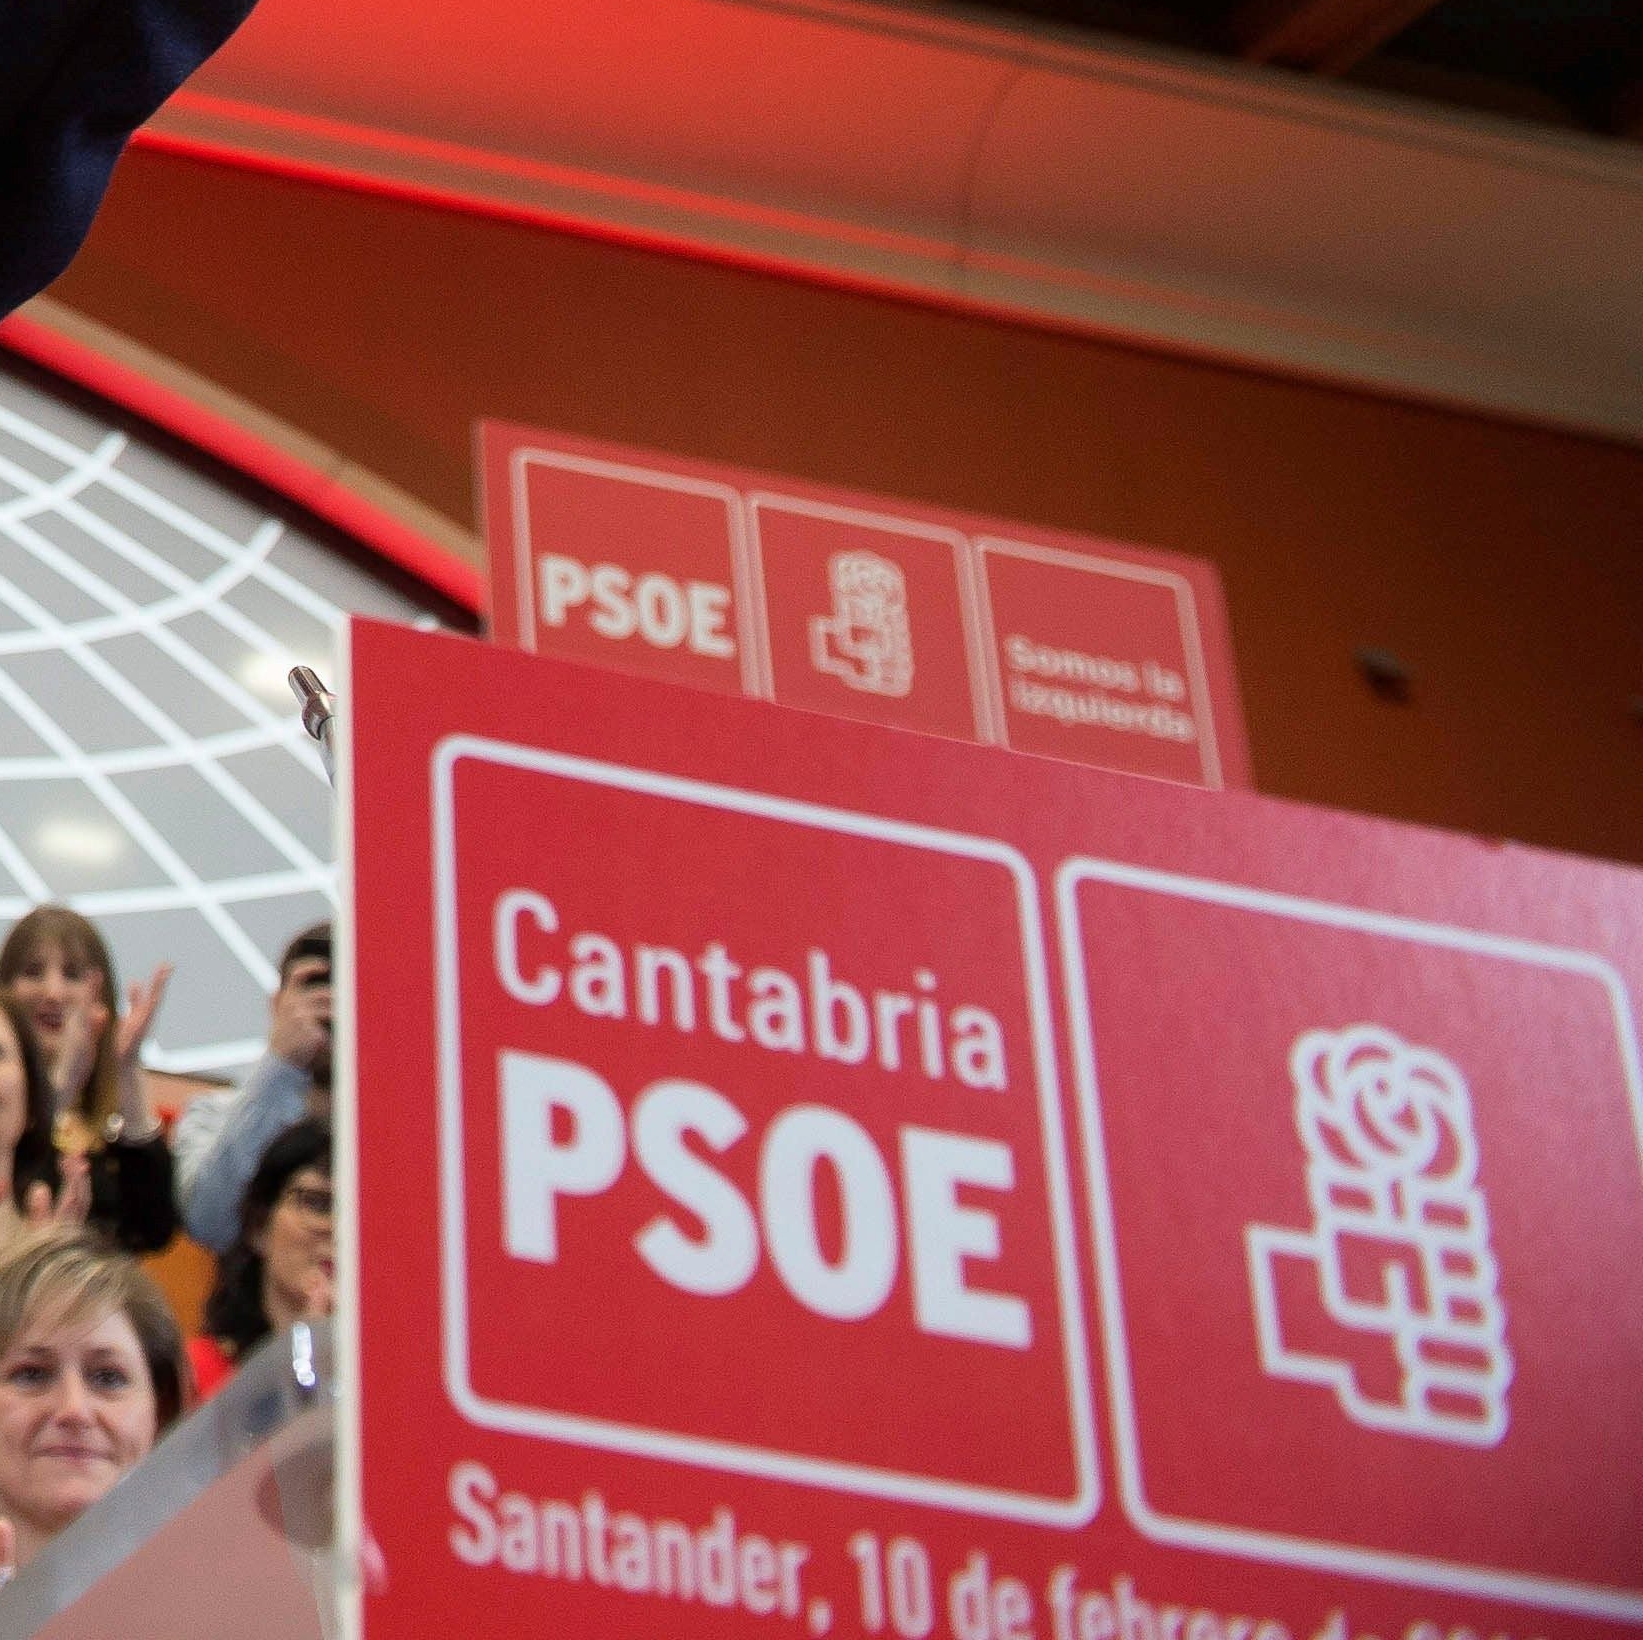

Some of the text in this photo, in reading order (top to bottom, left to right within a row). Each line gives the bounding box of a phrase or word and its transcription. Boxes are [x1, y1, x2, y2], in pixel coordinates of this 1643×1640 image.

[539, 554, 735, 657] PSOE
[1004, 635, 1185, 702] Somos la
[494, 888, 1007, 1090] Cantabria
[499, 1050, 1032, 1349] PSOE
[448, 1462, 832, 1636] Santander,
[848, 1532, 933, 1639] 10
[949, 1551, 1033, 1640] de
